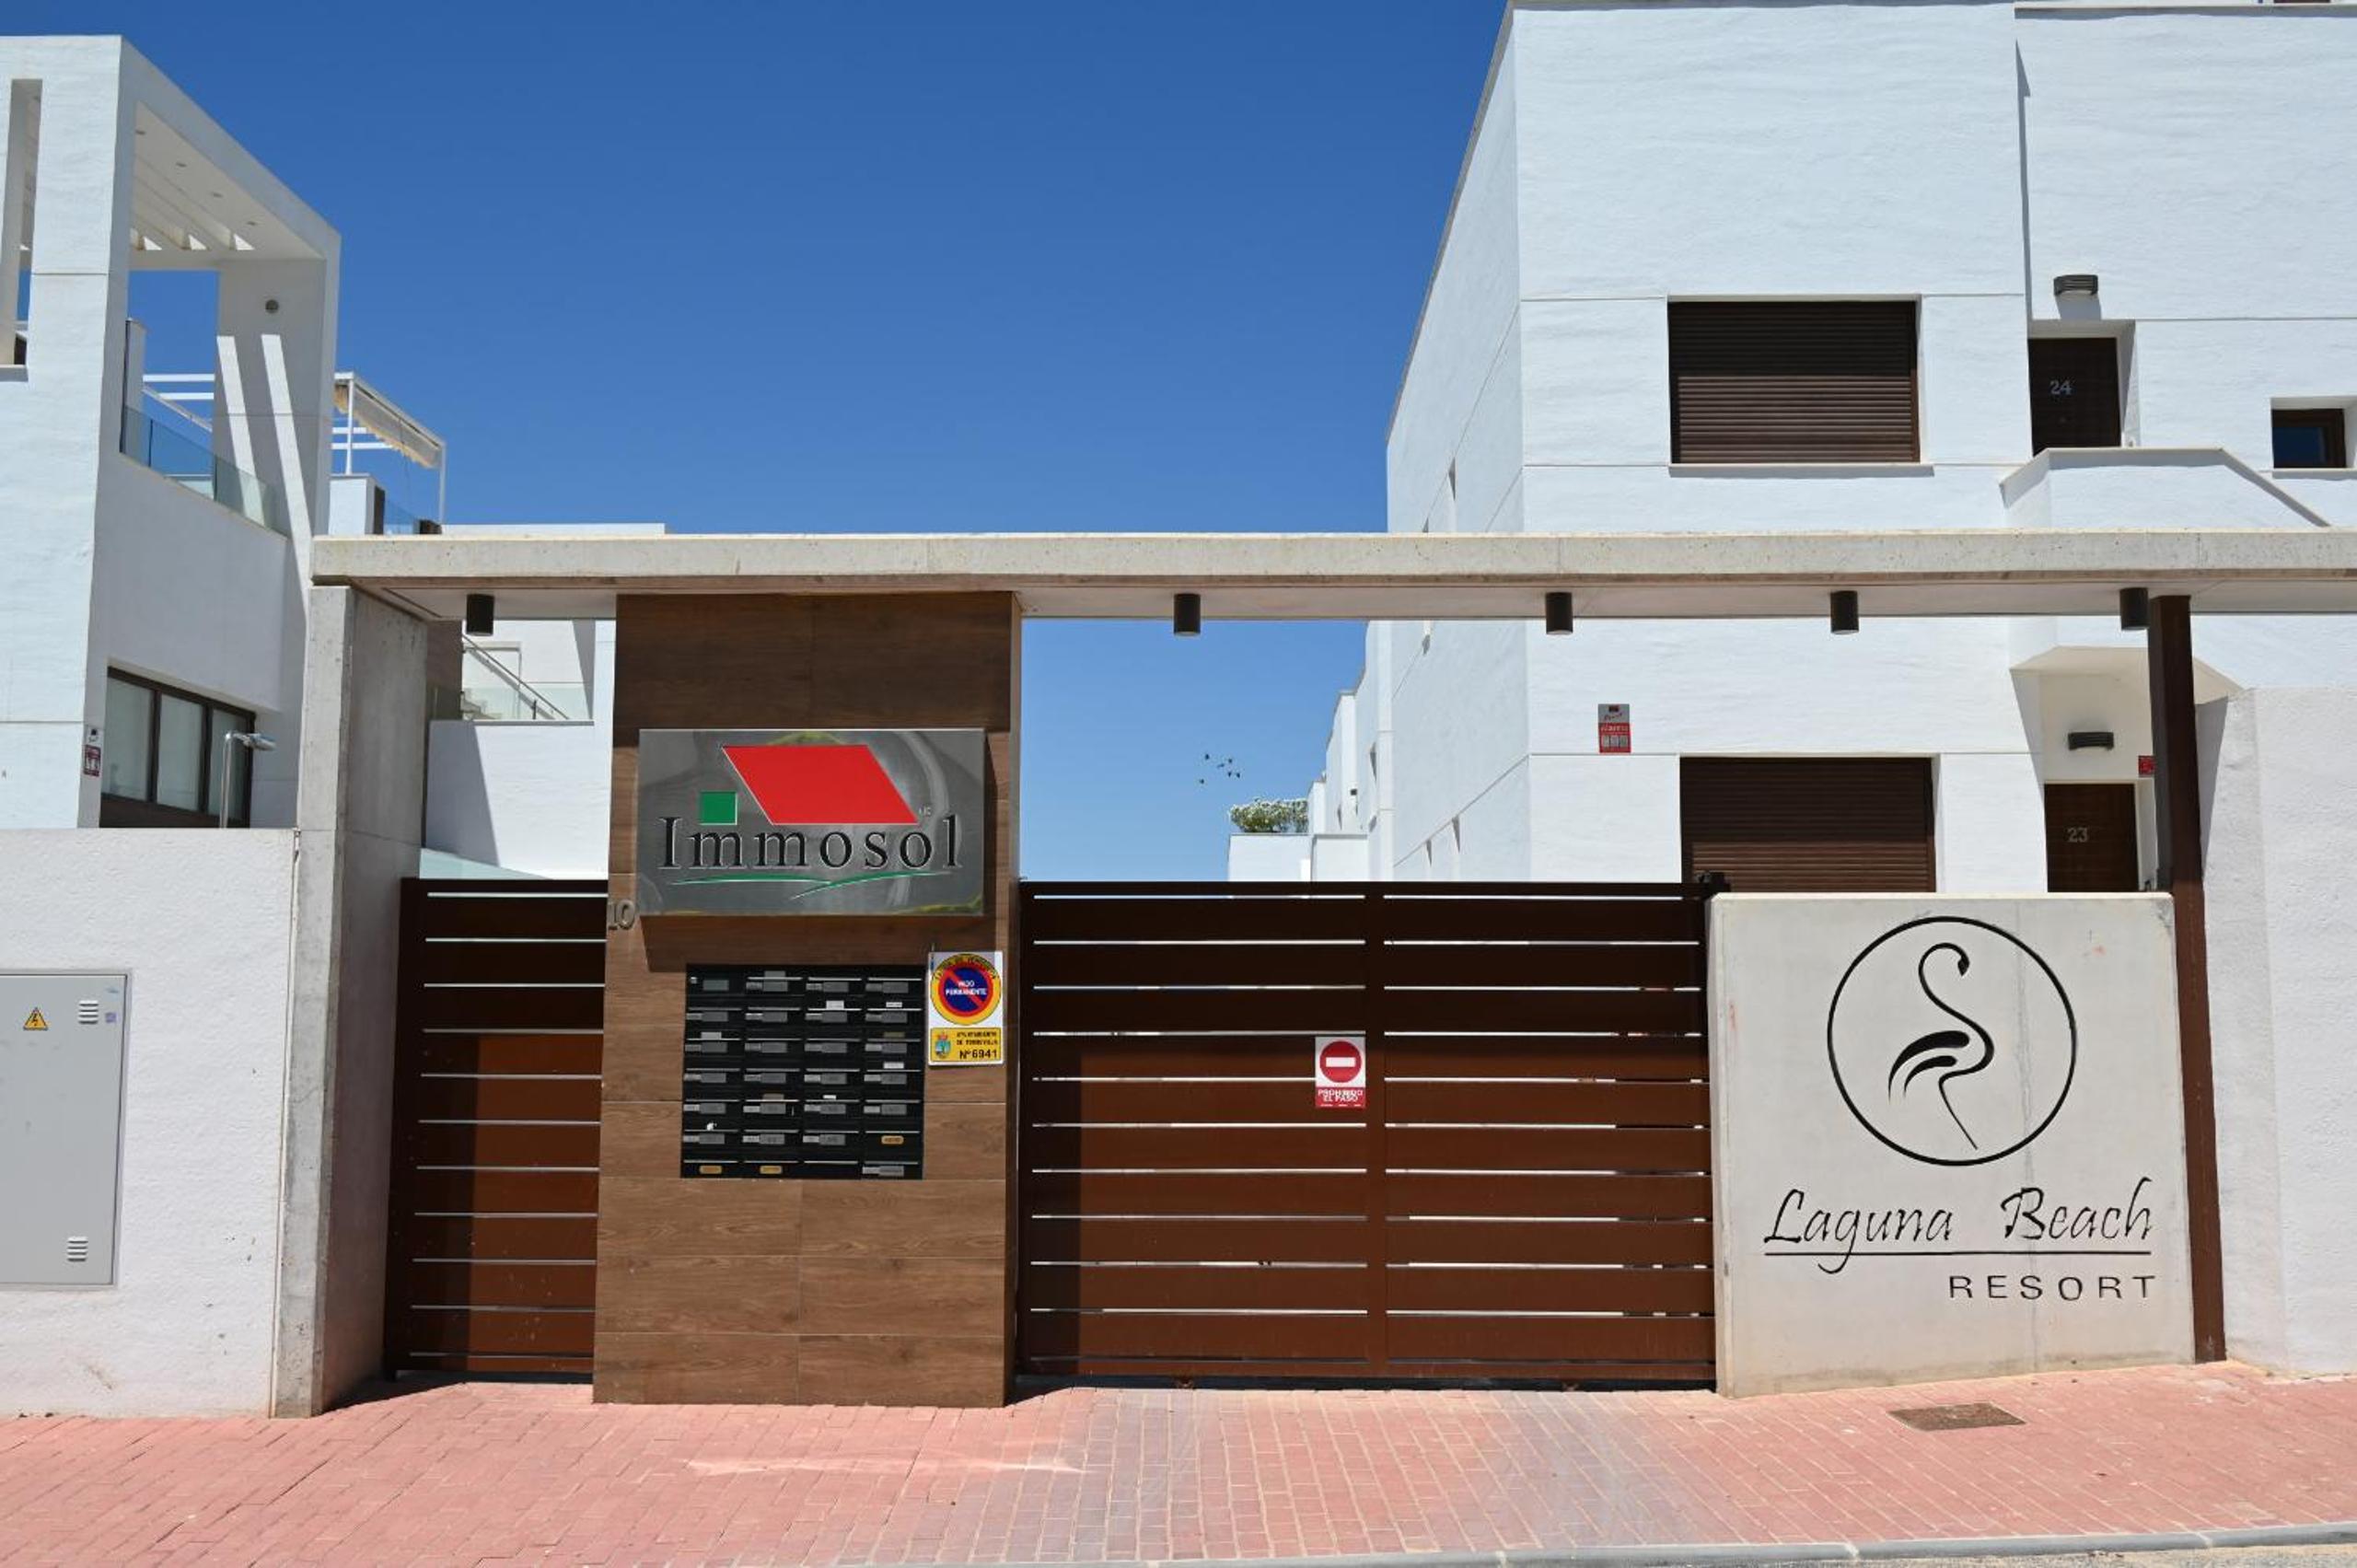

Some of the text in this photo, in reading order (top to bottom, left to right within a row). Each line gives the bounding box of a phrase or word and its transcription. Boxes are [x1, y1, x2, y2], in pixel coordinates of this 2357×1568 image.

[2049, 379, 2073, 396] 24
[657, 815, 963, 870] Immosol
[2066, 827, 2089, 842] 23
[606, 900, 635, 929] 10
[1763, 1176, 2154, 1274] Laguna Beach
[1948, 1274, 2156, 1302] RESORT
